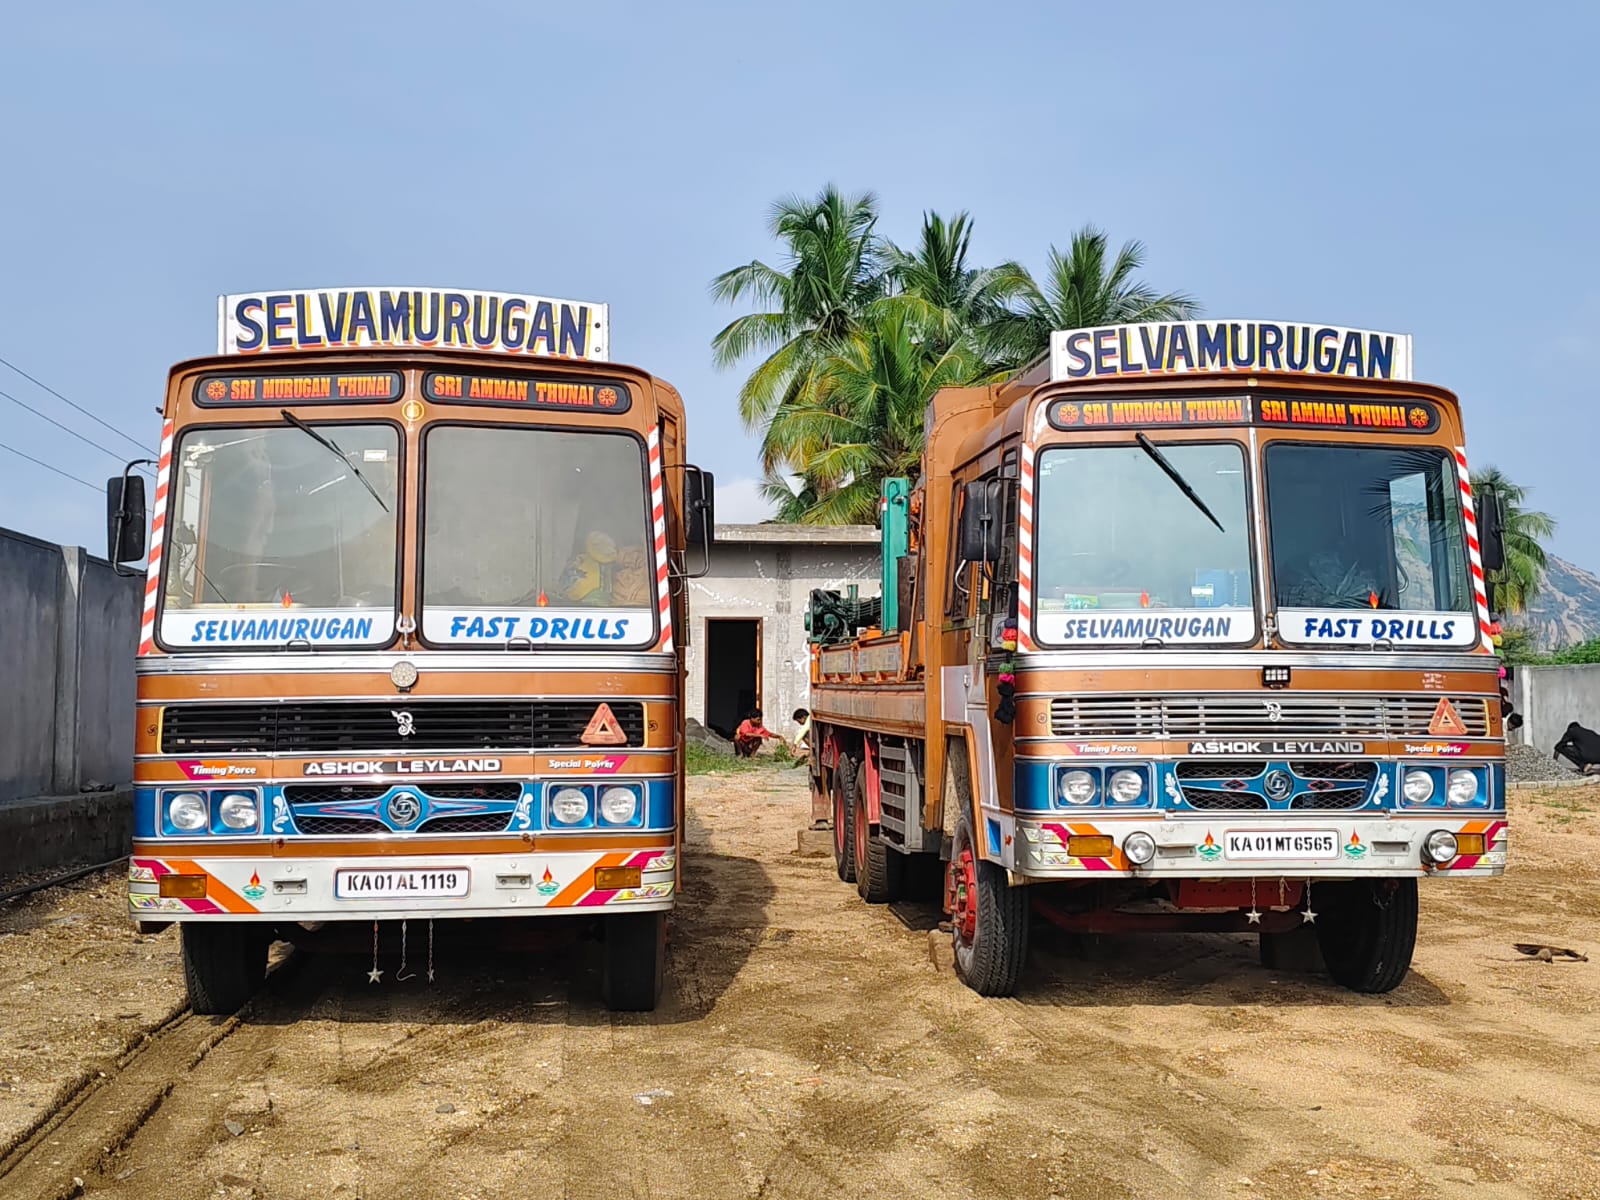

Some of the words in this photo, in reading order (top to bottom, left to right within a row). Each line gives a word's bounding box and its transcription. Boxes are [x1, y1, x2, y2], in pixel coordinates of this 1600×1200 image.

[235, 291, 590, 358] SELVAMURUGAN
[1065, 323, 1396, 379] SELVAMURUGAN
[231, 378, 256, 400] SRI
[262, 377, 331, 399] MURUGAN
[337, 376, 392, 397] THUNAI
[433, 376, 463, 396] SRI
[469, 378, 528, 401] AMMAN
[536, 382, 595, 406] THUNAI
[1082, 402, 1110, 425] SRI
[1113, 401, 1182, 424] MURUGAN
[1186, 400, 1244, 423] THUNAI
[1261, 400, 1288, 423] SRI
[1291, 402, 1347, 425] AMMAN
[1350, 403, 1407, 428] THUNAI
[191, 617, 373, 643] SELVAMURUGAN
[450, 617, 524, 641] FAST
[529, 618, 630, 641] DRILLS
[1064, 617, 1232, 640] SELVAMURUGAN
[1304, 618, 1363, 640] FAST
[1371, 619, 1456, 641] DRILLS
[1076, 744, 1110, 754] Timing
[1111, 744, 1138, 753] Force
[1191, 741, 1261, 754] ASHOK
[1273, 742, 1364, 753] LEYLAND
[1404, 743, 1434, 754] Special
[1436, 744, 1462, 754] Power
[190, 765, 227, 776] Timing
[228, 766, 257, 775] Force
[305, 761, 384, 775] ASHOK
[397, 759, 500, 774] LEYLAND
[548, 759, 581, 769] Special
[584, 759, 615, 769] Power
